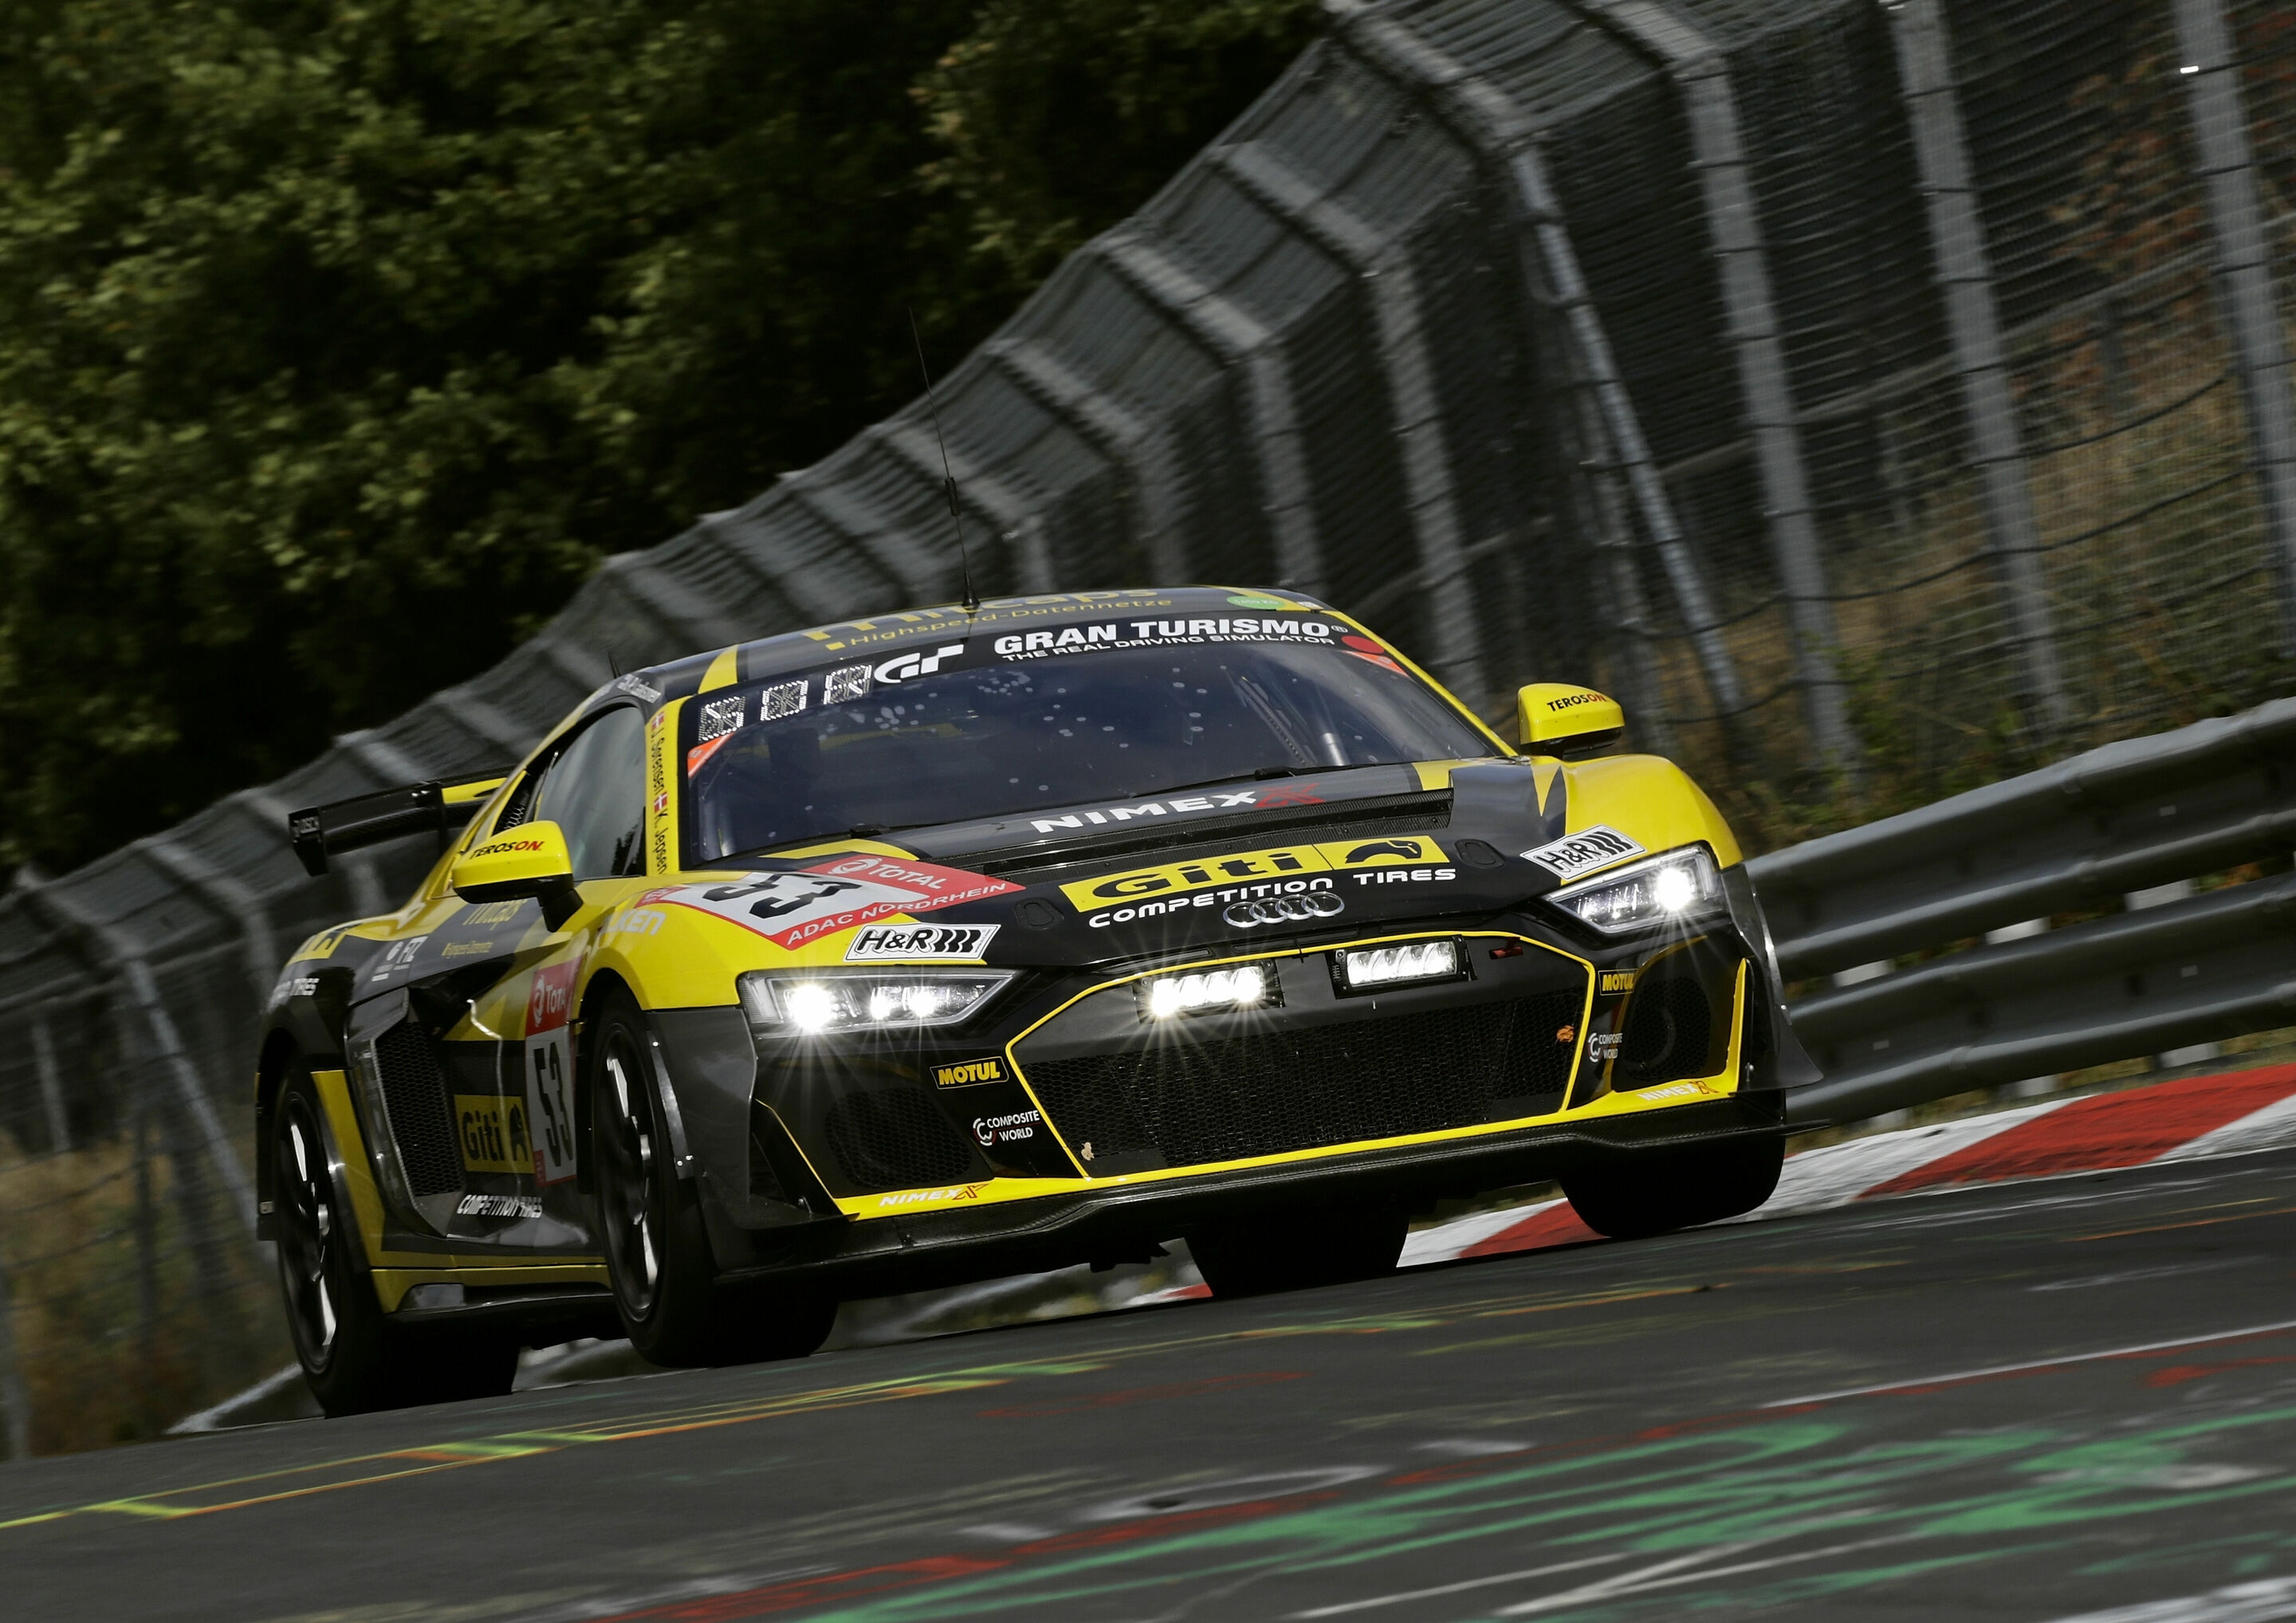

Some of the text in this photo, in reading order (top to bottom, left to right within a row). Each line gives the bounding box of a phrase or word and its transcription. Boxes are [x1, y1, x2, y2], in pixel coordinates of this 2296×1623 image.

[993, 624, 1117, 654] GRAN
[1002, 635, 1335, 662] THE REAL DRIVING SIMULATOR
[1547, 694, 1607, 712] TEROSON
[470, 840, 545, 859] TEROSON
[652, 827, 669, 874] Jepsen
[1536, 842, 1602, 871] H&R
[868, 863, 947, 890] TOTAL
[1092, 852, 1303, 898] Giti
[702, 874, 863, 919] 53
[1088, 868, 1457, 928] COMPETITION TIRES
[787, 882, 1007, 946] ADAC NORDRHEIN
[855, 928, 939, 954] H&R
[1602, 973, 1634, 992] MOTUL
[1598, 1033, 1622, 1044] COMPOSITE
[938, 1061, 1001, 1085] MOTUL
[533, 1041, 573, 1167] 53
[986, 1110, 1040, 1129] COMPOSITE
[462, 1110, 505, 1161] Giti
[999, 1126, 1034, 1142] WORLD
